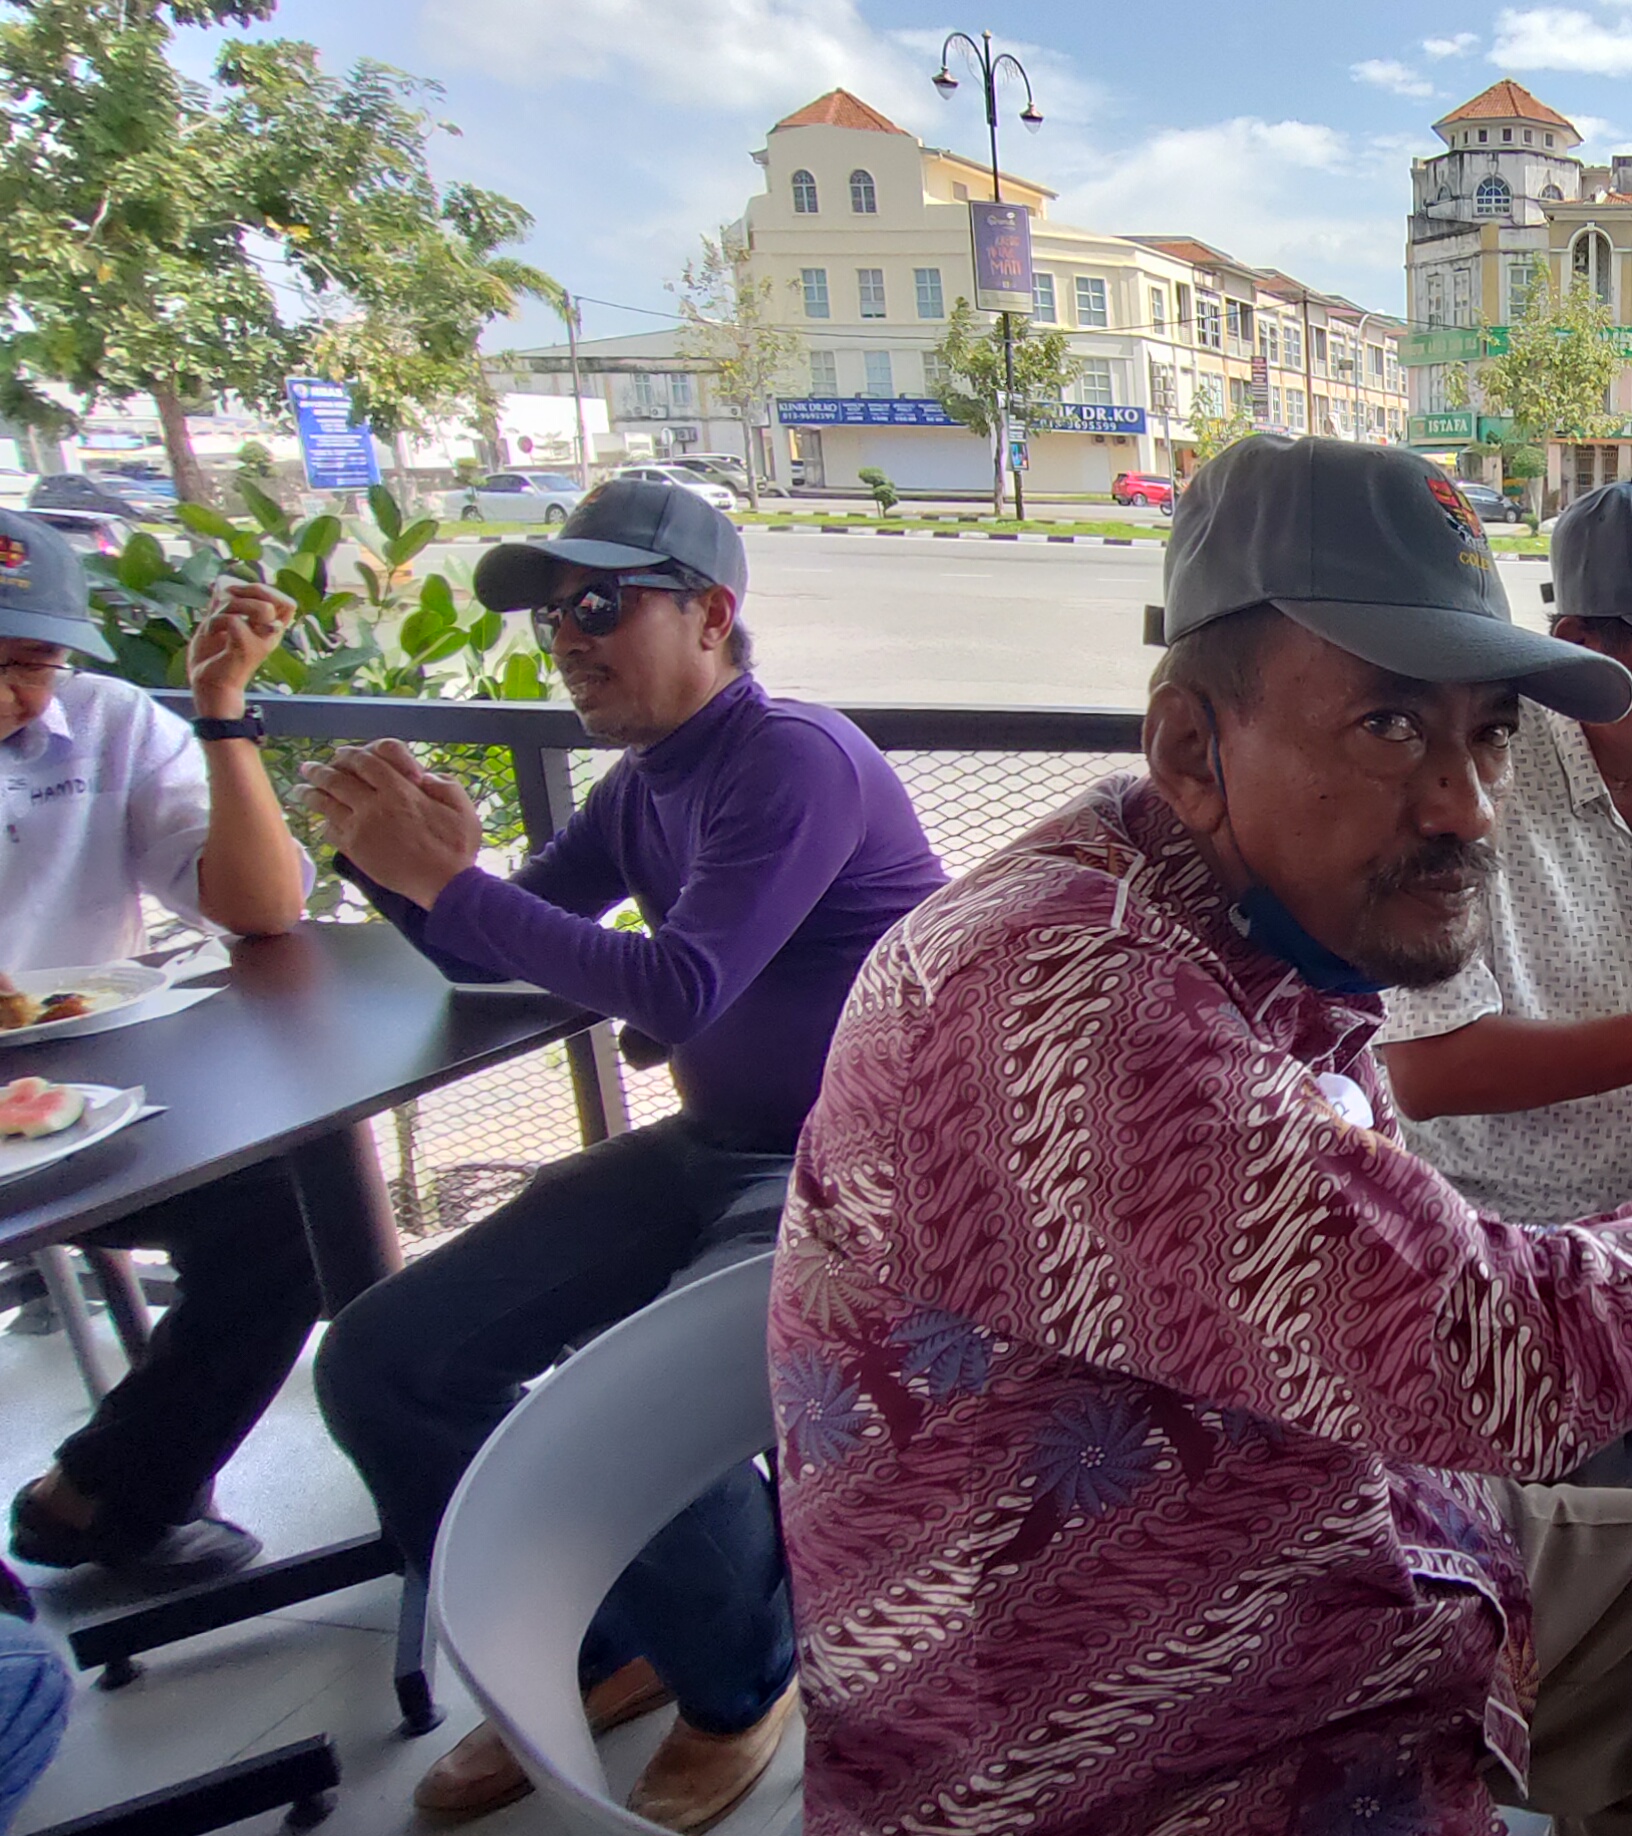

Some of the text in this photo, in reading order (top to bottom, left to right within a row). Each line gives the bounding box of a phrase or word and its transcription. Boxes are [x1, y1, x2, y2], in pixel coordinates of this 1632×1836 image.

[778, 402, 808, 412] KLINIK
[1082, 406, 1139, 423] DR.KO
[1428, 419, 1469, 433] ISTAFA
